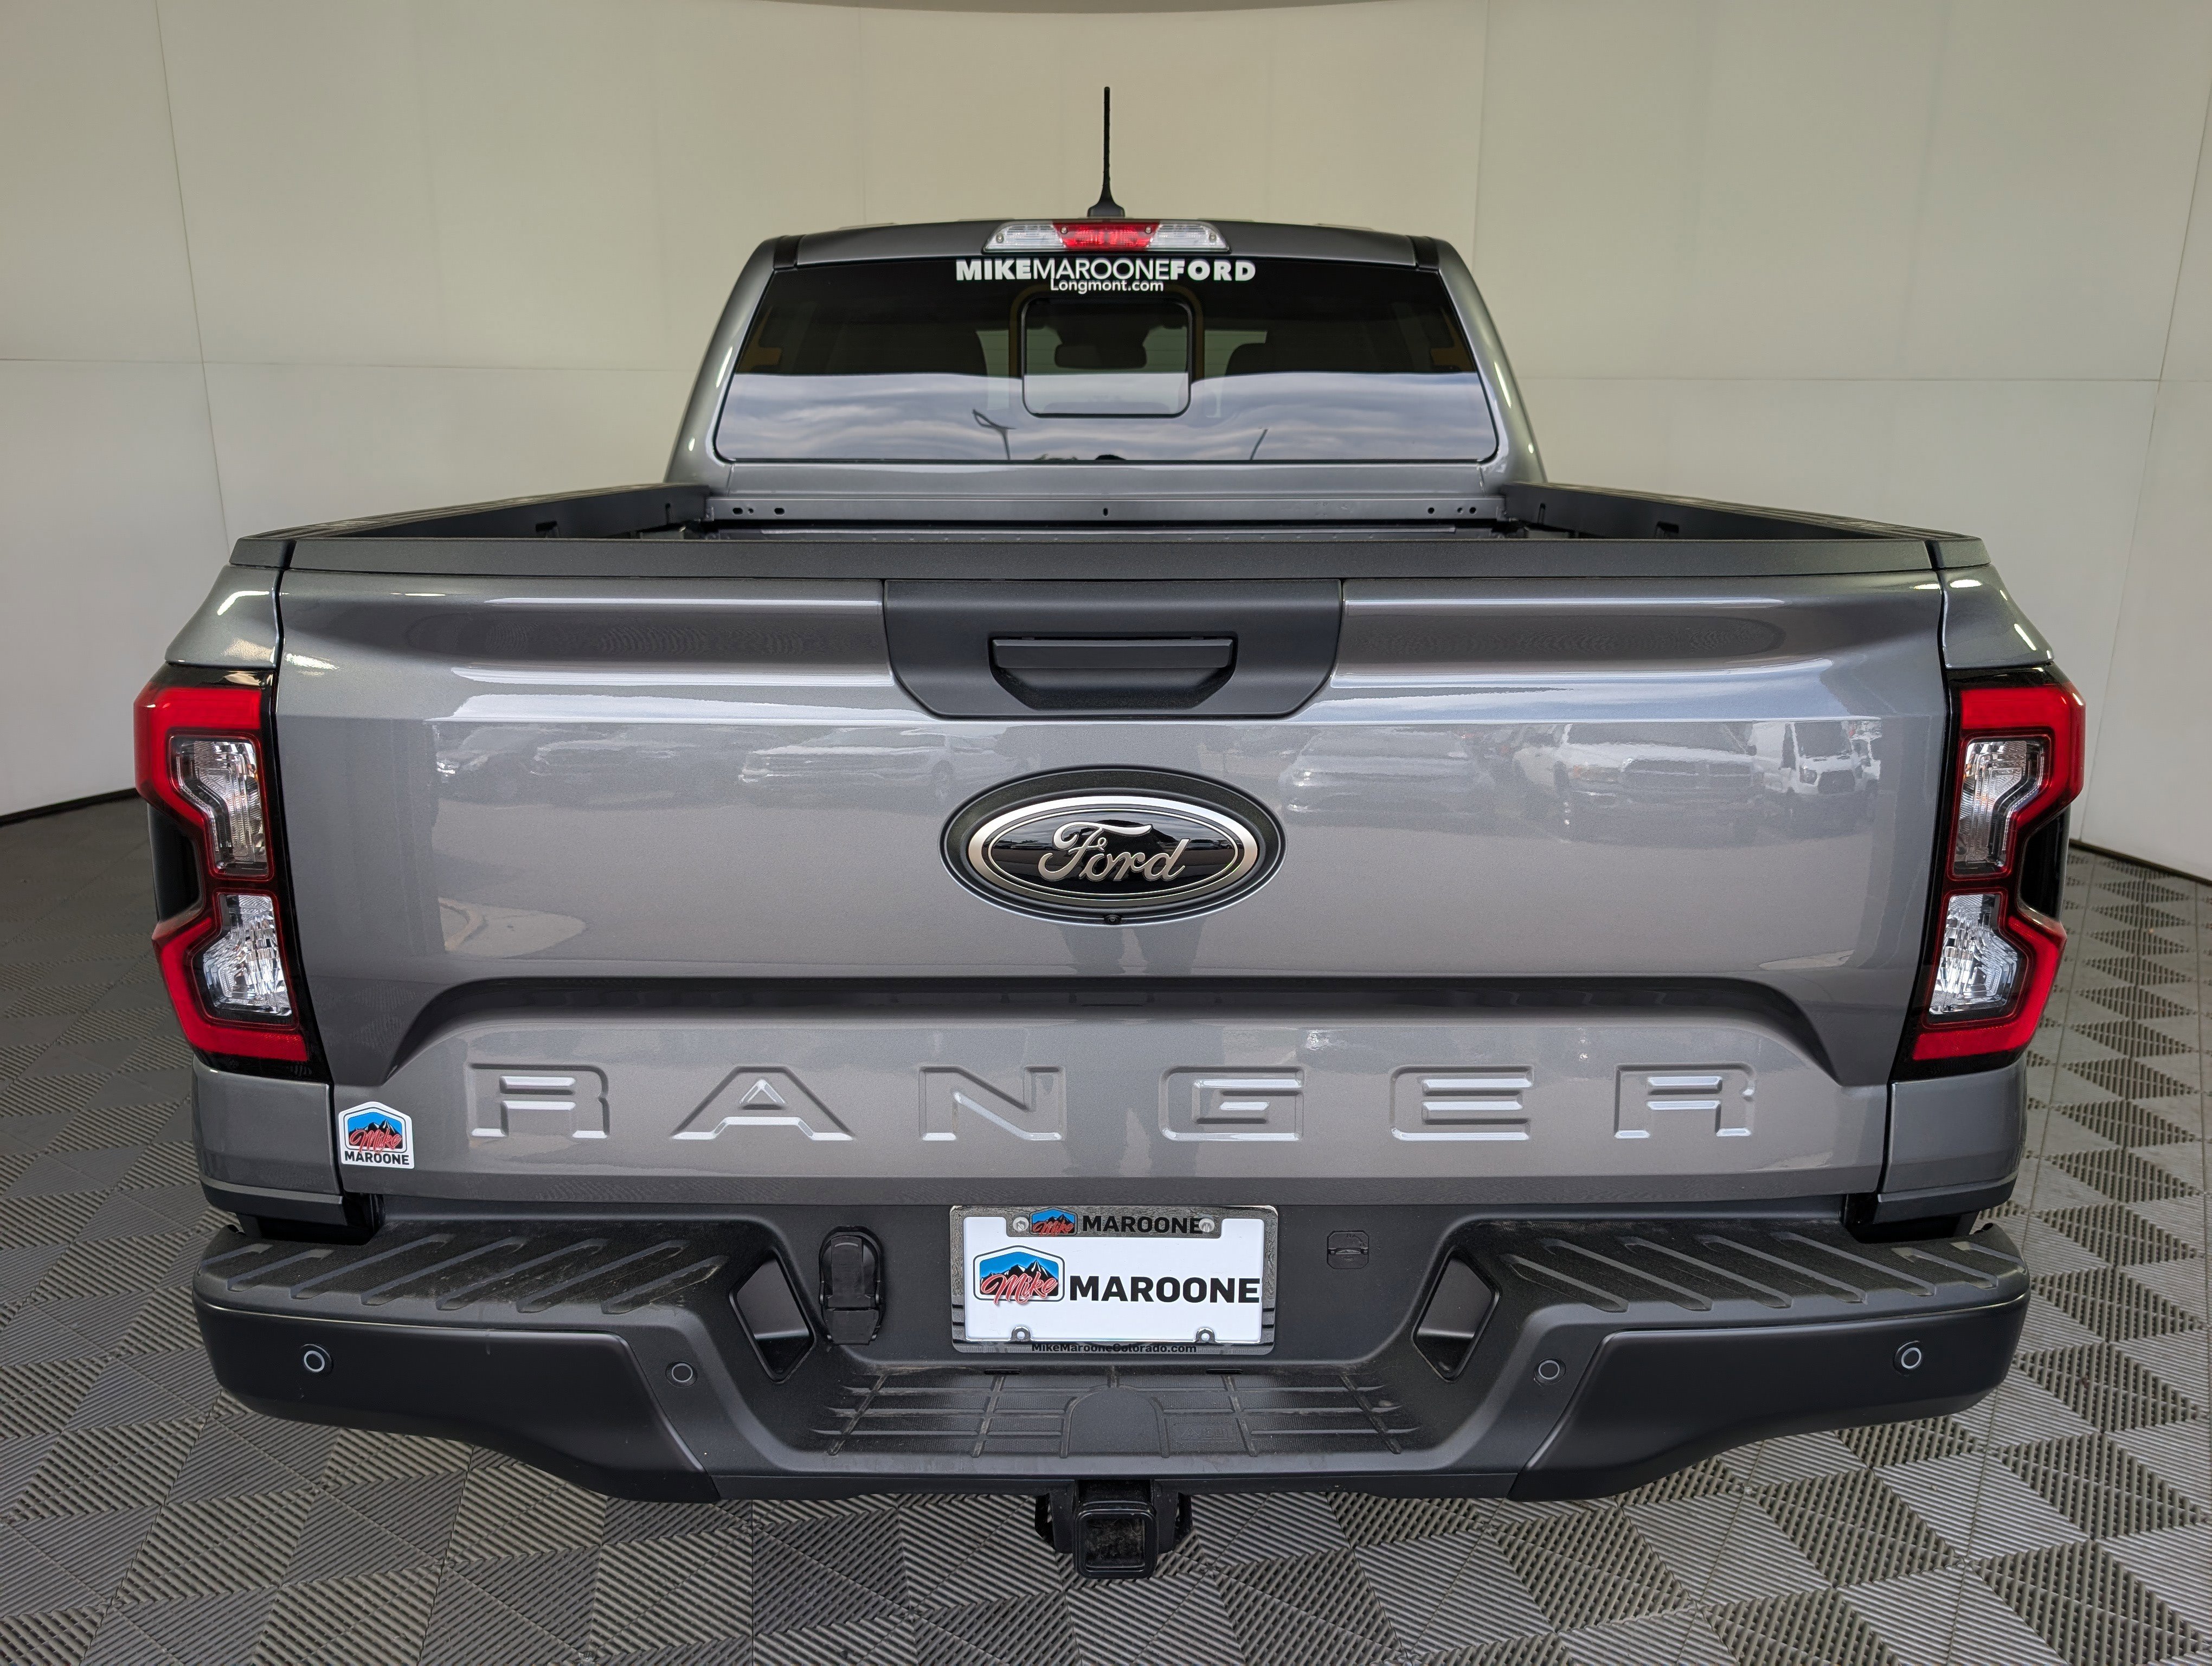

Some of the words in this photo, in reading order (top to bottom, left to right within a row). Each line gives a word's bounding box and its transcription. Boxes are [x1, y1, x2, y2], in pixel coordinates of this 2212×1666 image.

[1050, 278, 1164, 294] Longmont.com
[1038, 822, 1191, 882] Ford
[465, 1063, 1756, 1141] RANGER
[349, 1128, 402, 1154] Mike
[344, 1150, 410, 1165] MAROONE
[1032, 1220, 1073, 1236] Mike
[1082, 1215, 1204, 1234] MAROONE
[980, 1273, 1058, 1305] Mike
[1070, 1275, 1261, 1303] MAROONE
[1031, 1343, 1197, 1353] MikeMarooneColorado.com
